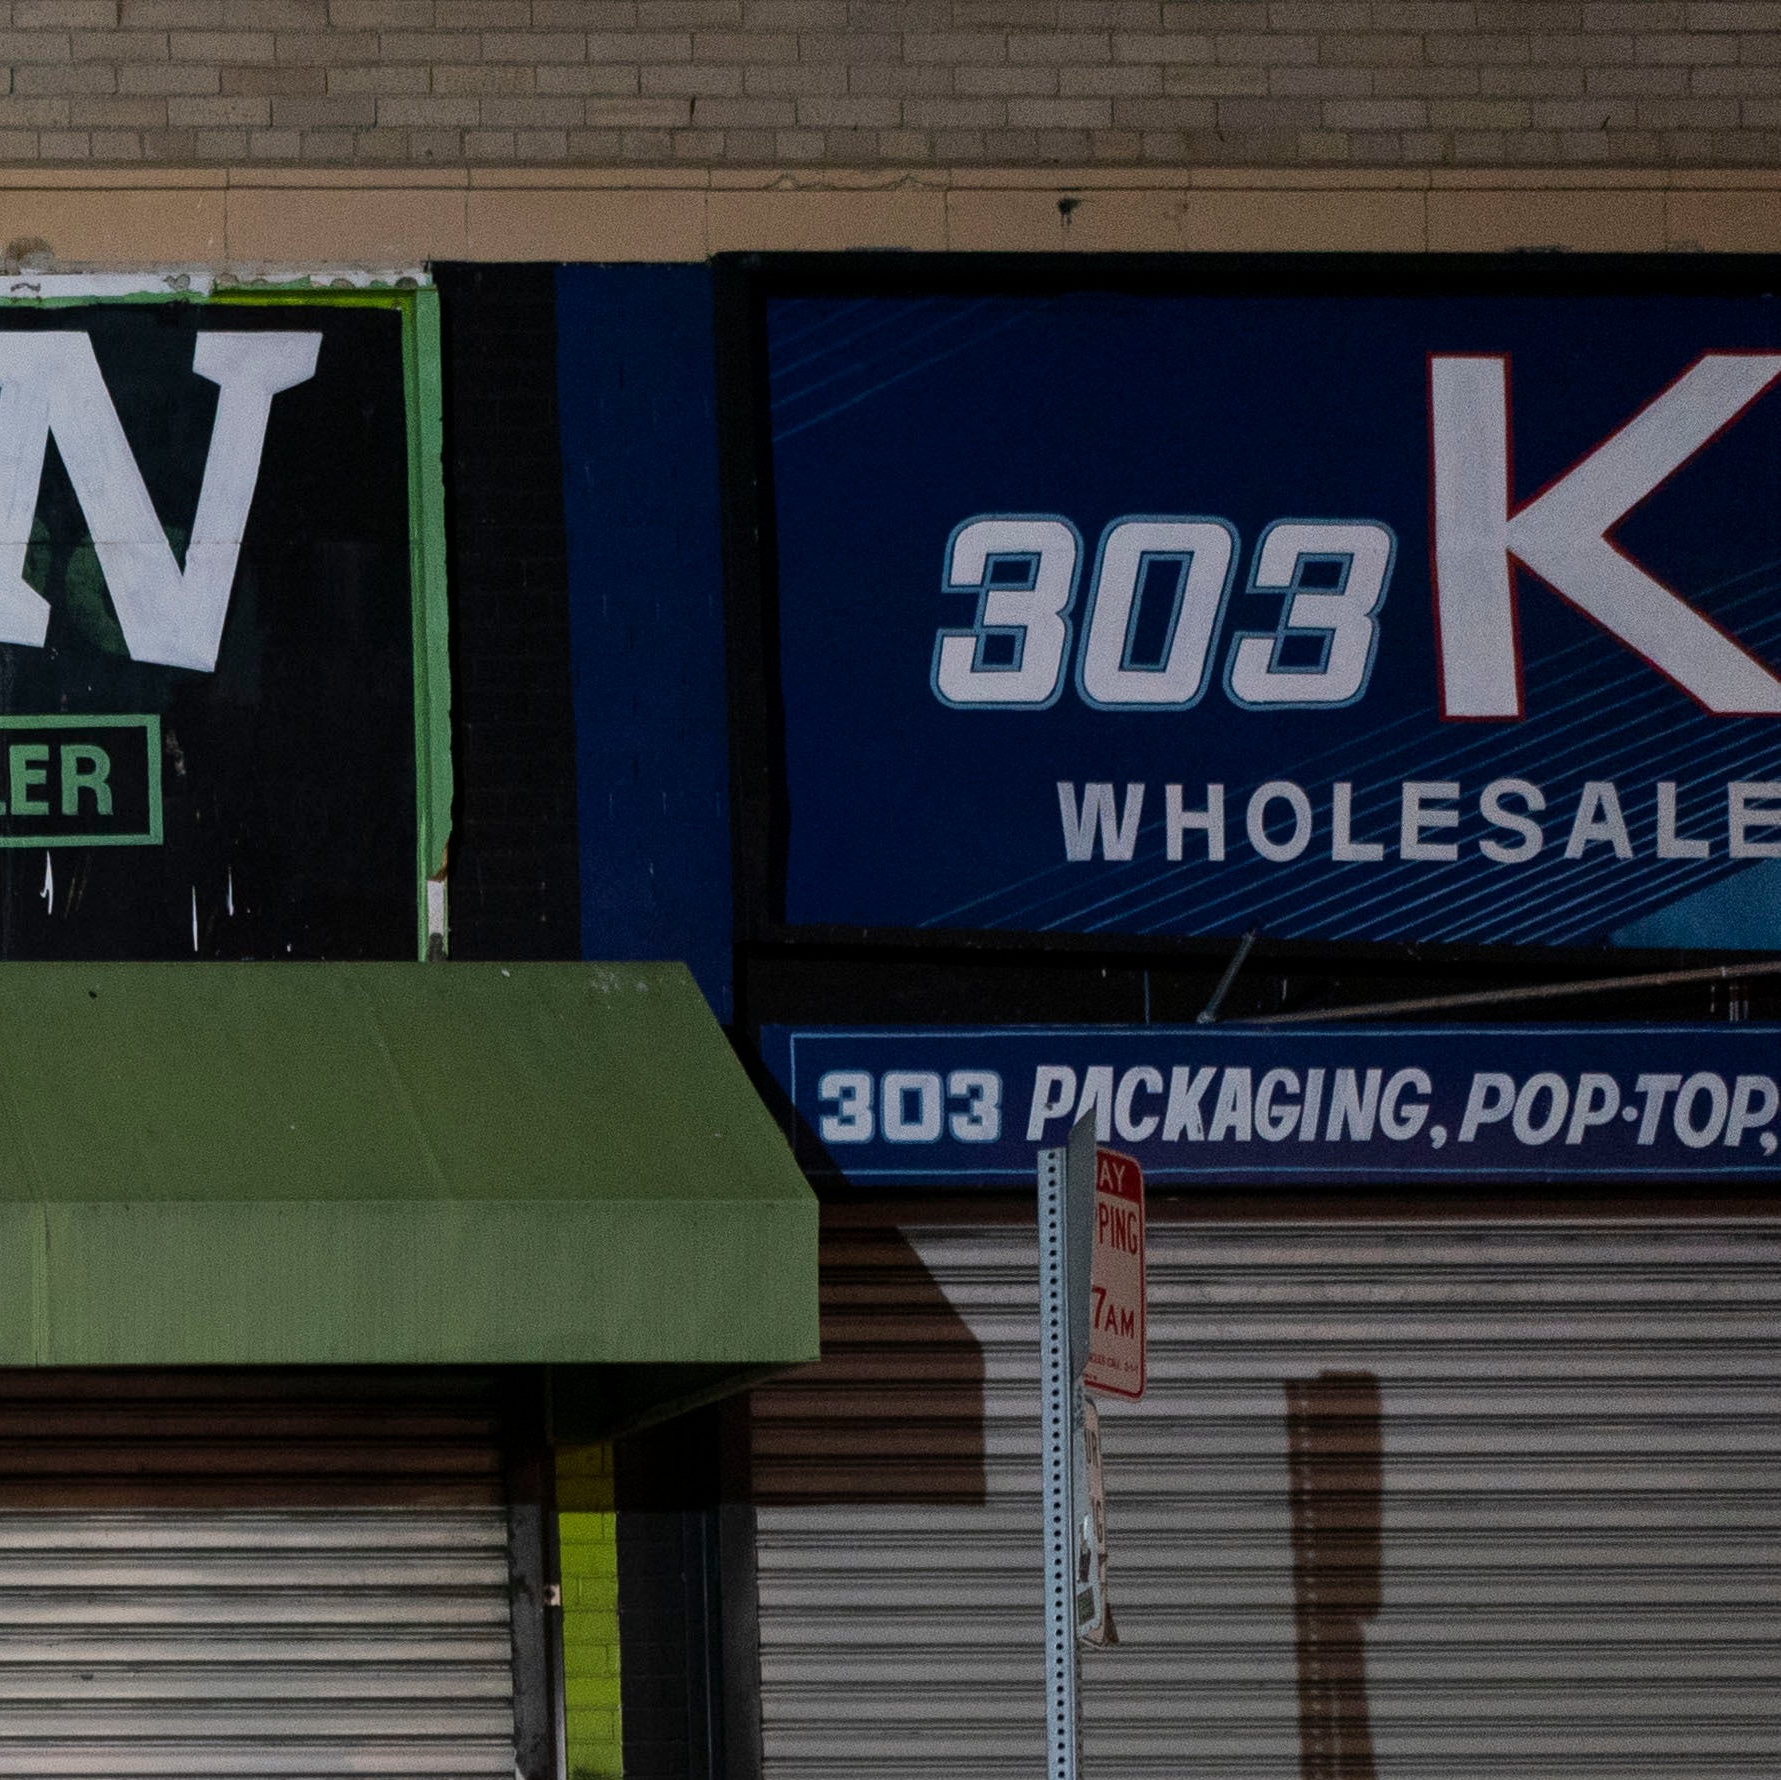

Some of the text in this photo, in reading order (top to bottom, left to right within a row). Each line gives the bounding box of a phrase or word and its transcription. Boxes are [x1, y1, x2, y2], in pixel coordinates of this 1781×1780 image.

[928, 512, 1398, 712] 303
[1057, 778, 1781, 864] WHOLESALE
[819, 1069, 1003, 1144] 303
[1025, 1065, 1448, 1150] PACKAGING,
[1095, 1201, 1139, 1255] PING
